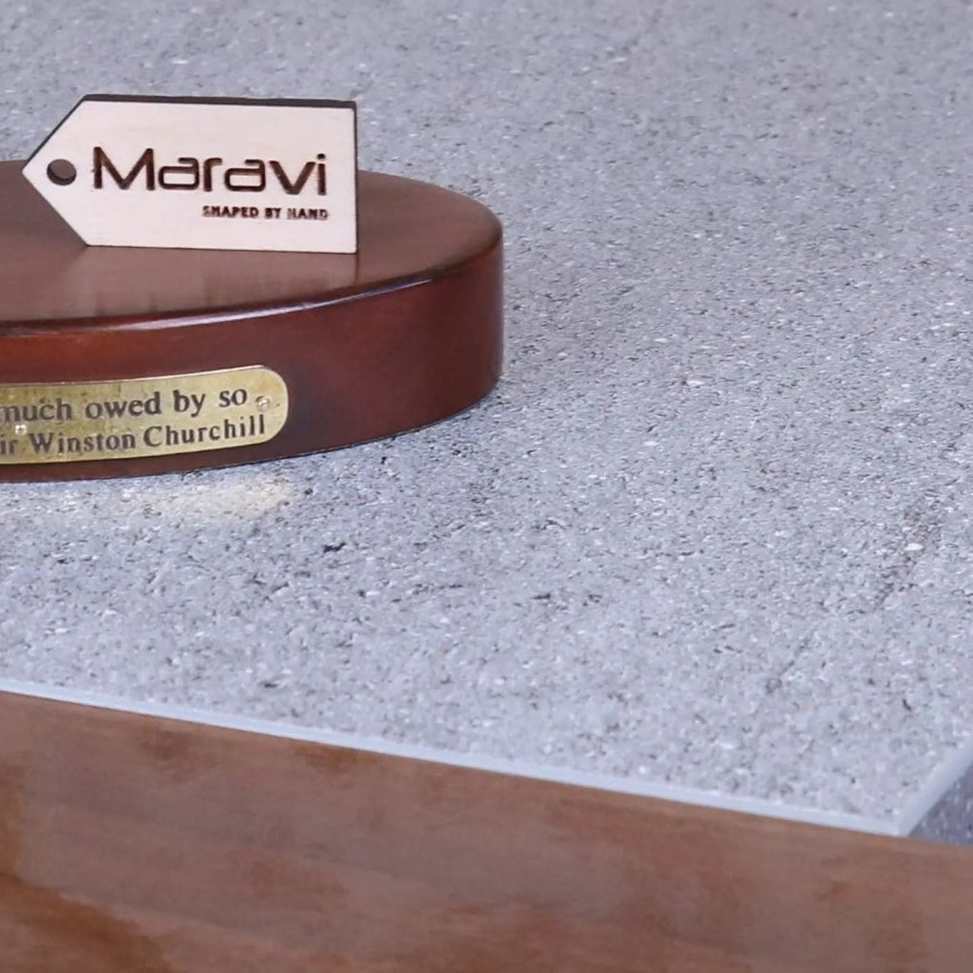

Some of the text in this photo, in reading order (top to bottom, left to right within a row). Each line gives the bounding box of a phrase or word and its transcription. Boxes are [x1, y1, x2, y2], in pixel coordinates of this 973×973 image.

[93, 146, 327, 196] Maravi
[202, 205, 329, 221] SHAPED BY HAND
[85, 390, 162, 420] owed
[173, 389, 207, 417] by
[218, 387, 247, 408] so
[29, 431, 136, 455] Winston
[143, 414, 266, 447] Churchill
